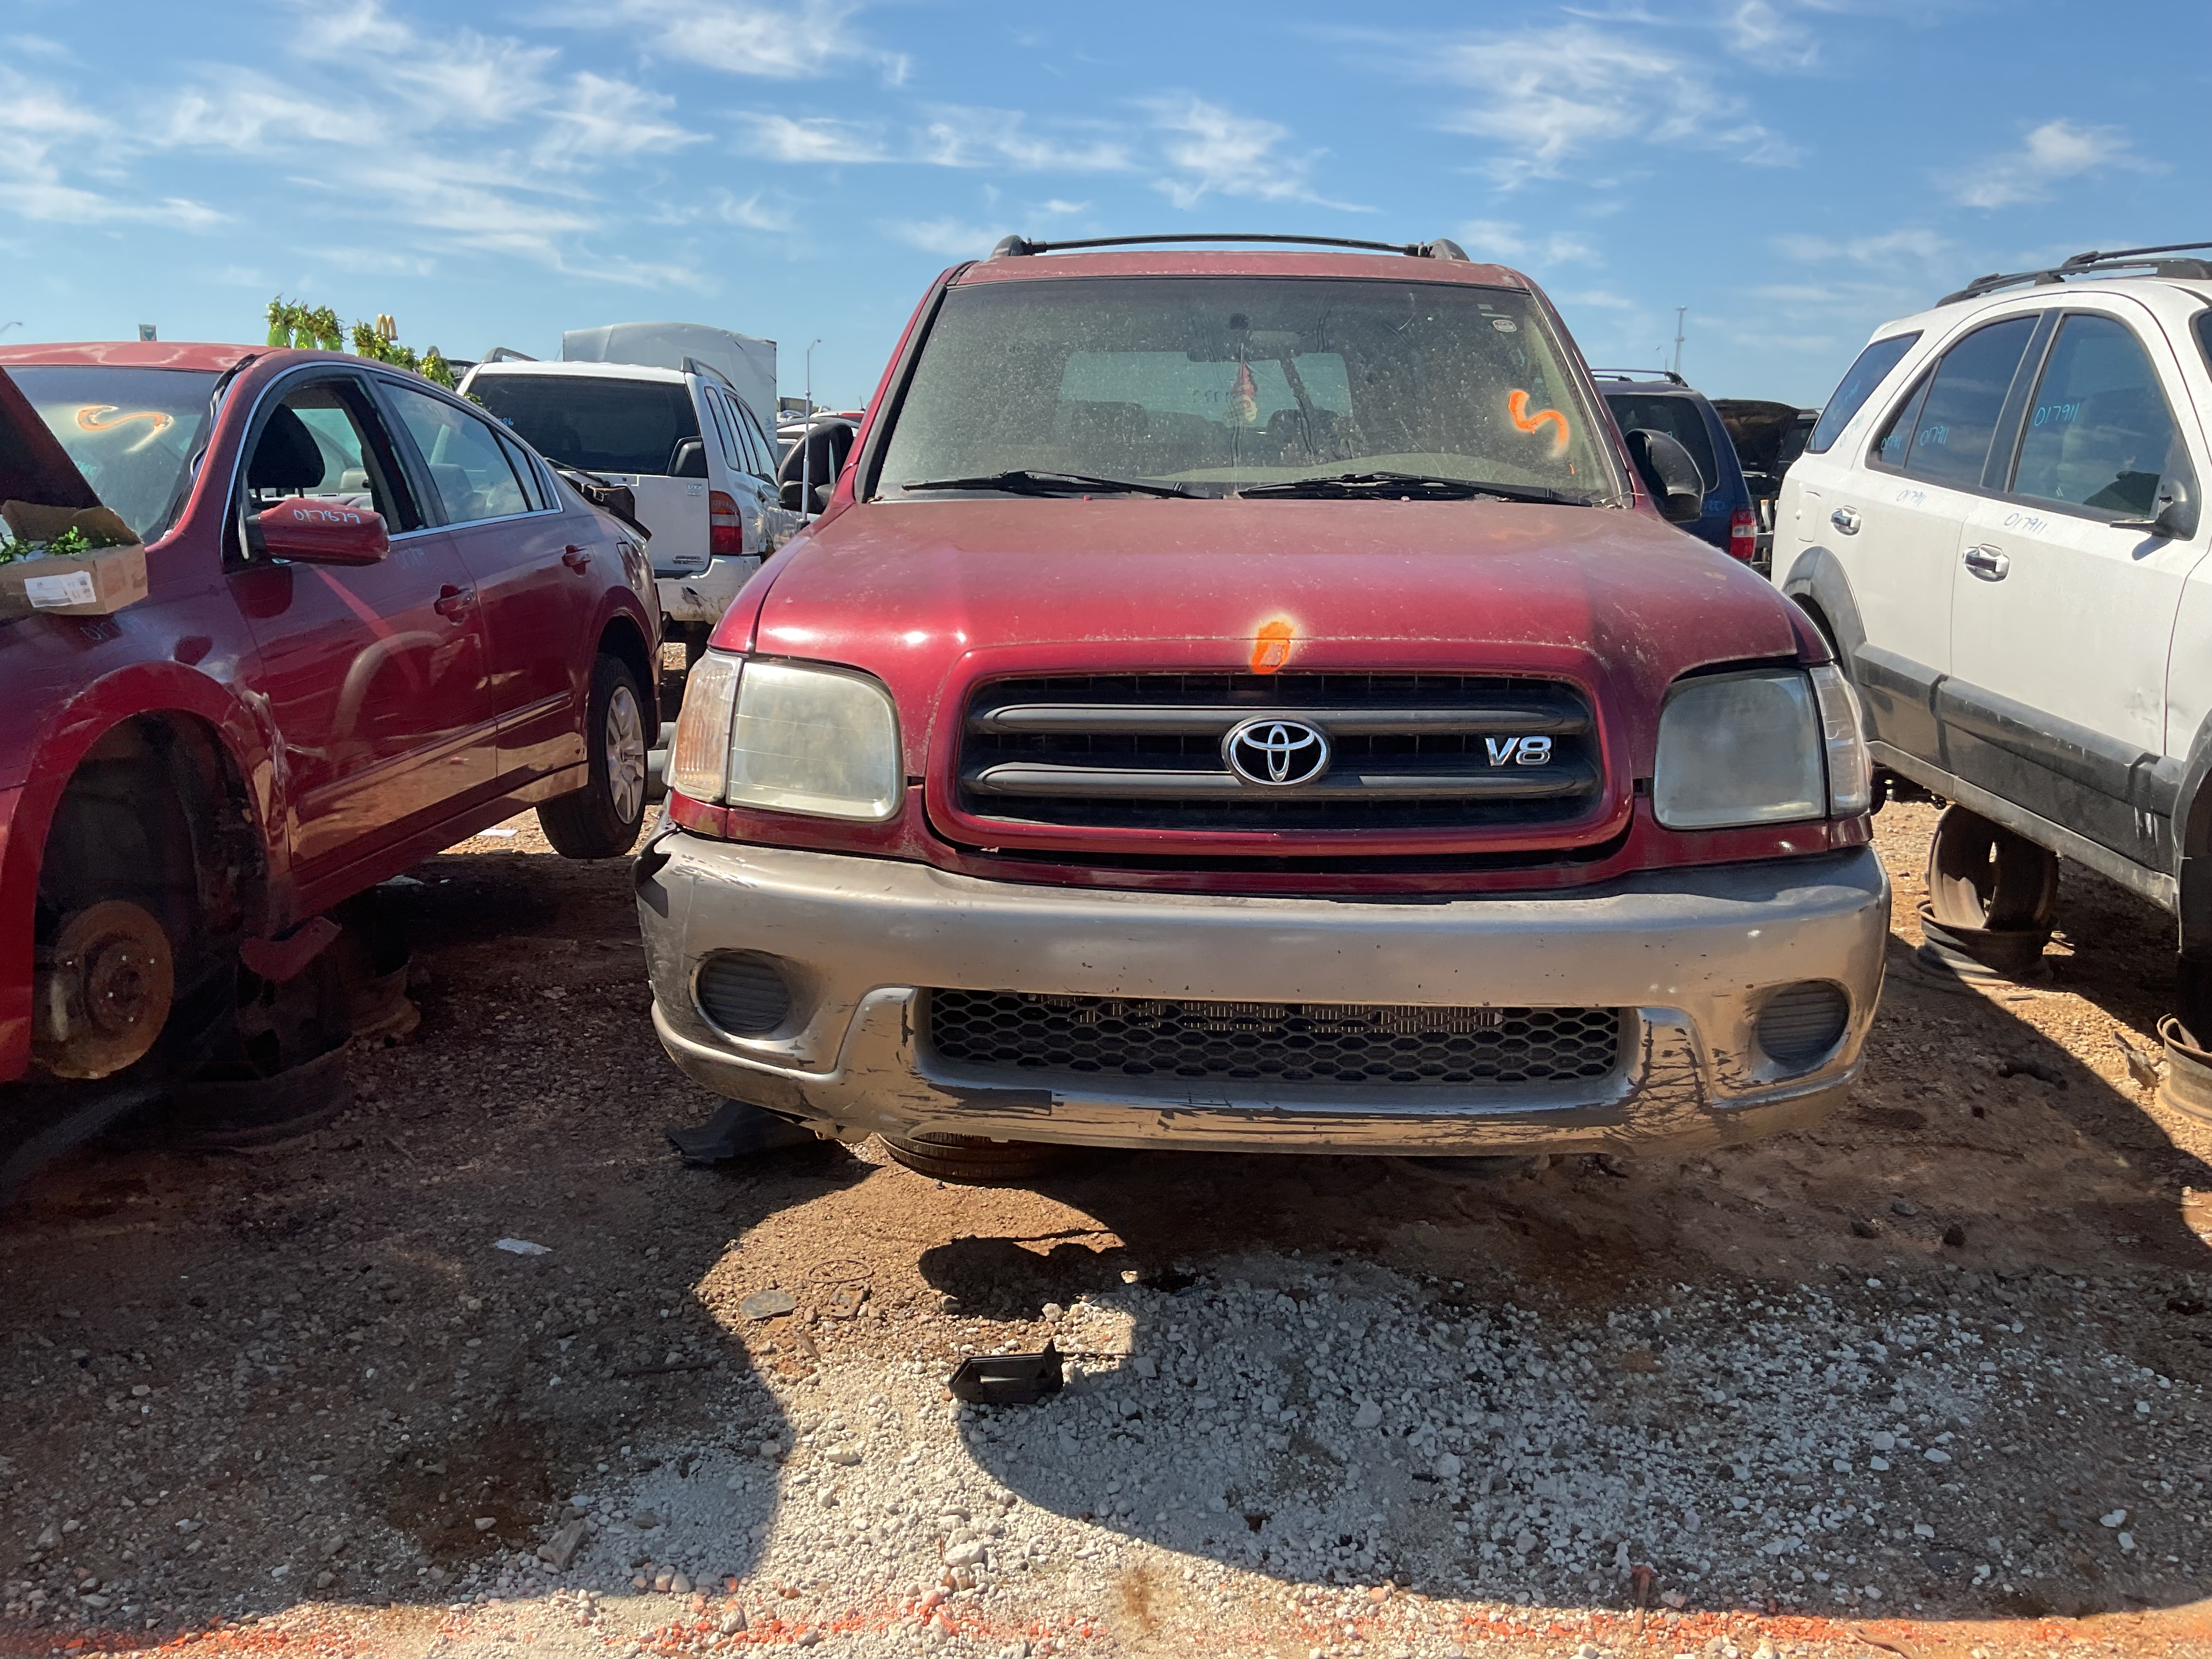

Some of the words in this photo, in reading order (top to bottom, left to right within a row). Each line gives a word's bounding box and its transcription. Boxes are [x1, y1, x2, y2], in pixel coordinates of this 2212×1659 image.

[2034, 403, 2080, 426] 017911
[294, 509, 361, 524] 017879
[2004, 513, 2048, 535] 017911
[1485, 736, 1551, 766] V8
